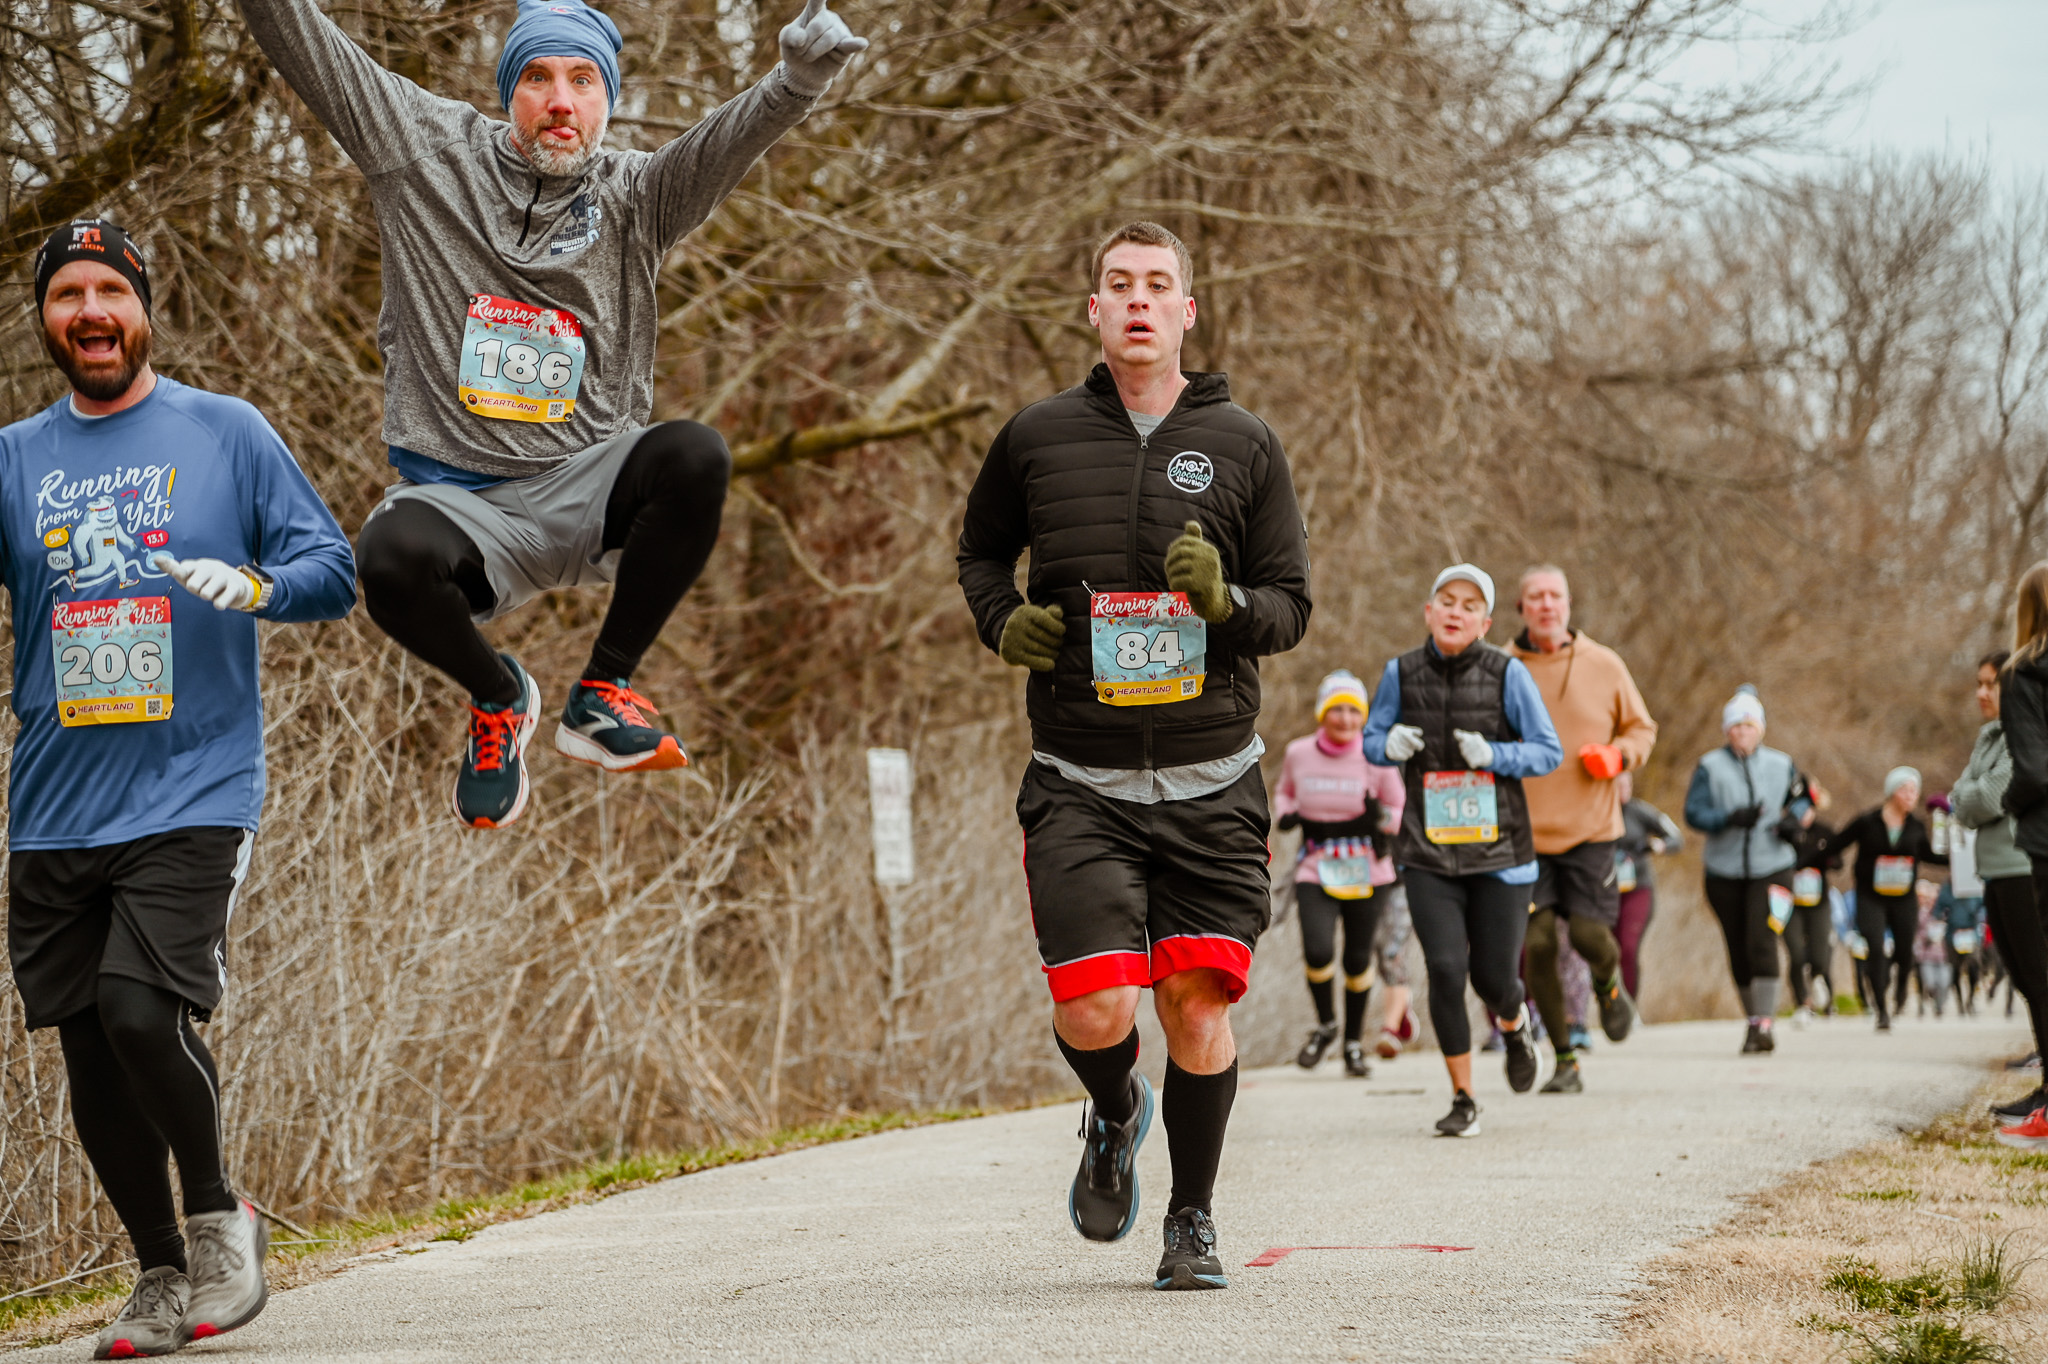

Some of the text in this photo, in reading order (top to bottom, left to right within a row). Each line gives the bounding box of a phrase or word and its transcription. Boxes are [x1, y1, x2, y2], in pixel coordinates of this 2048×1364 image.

[472, 295, 539, 333] Running
[474, 338, 573, 389] 186
[480, 397, 538, 412] HEARTLAND
[1169, 466, 1211, 483] Chocolate
[1175, 458, 1209, 473] HOT
[36, 462, 170, 509] Running
[35, 507, 82, 539] from
[48, 531, 164, 544] 5K 13.1
[50, 556, 68, 565] 10K
[54, 603, 117, 629] Running
[1094, 593, 1157, 619] Running
[1115, 630, 1184, 670] 84
[60, 641, 163, 687] 206
[1117, 685, 1171, 695] HEARTLAND
[77, 702, 134, 713] HEARTLAND
[1443, 797, 1480, 820] 16
